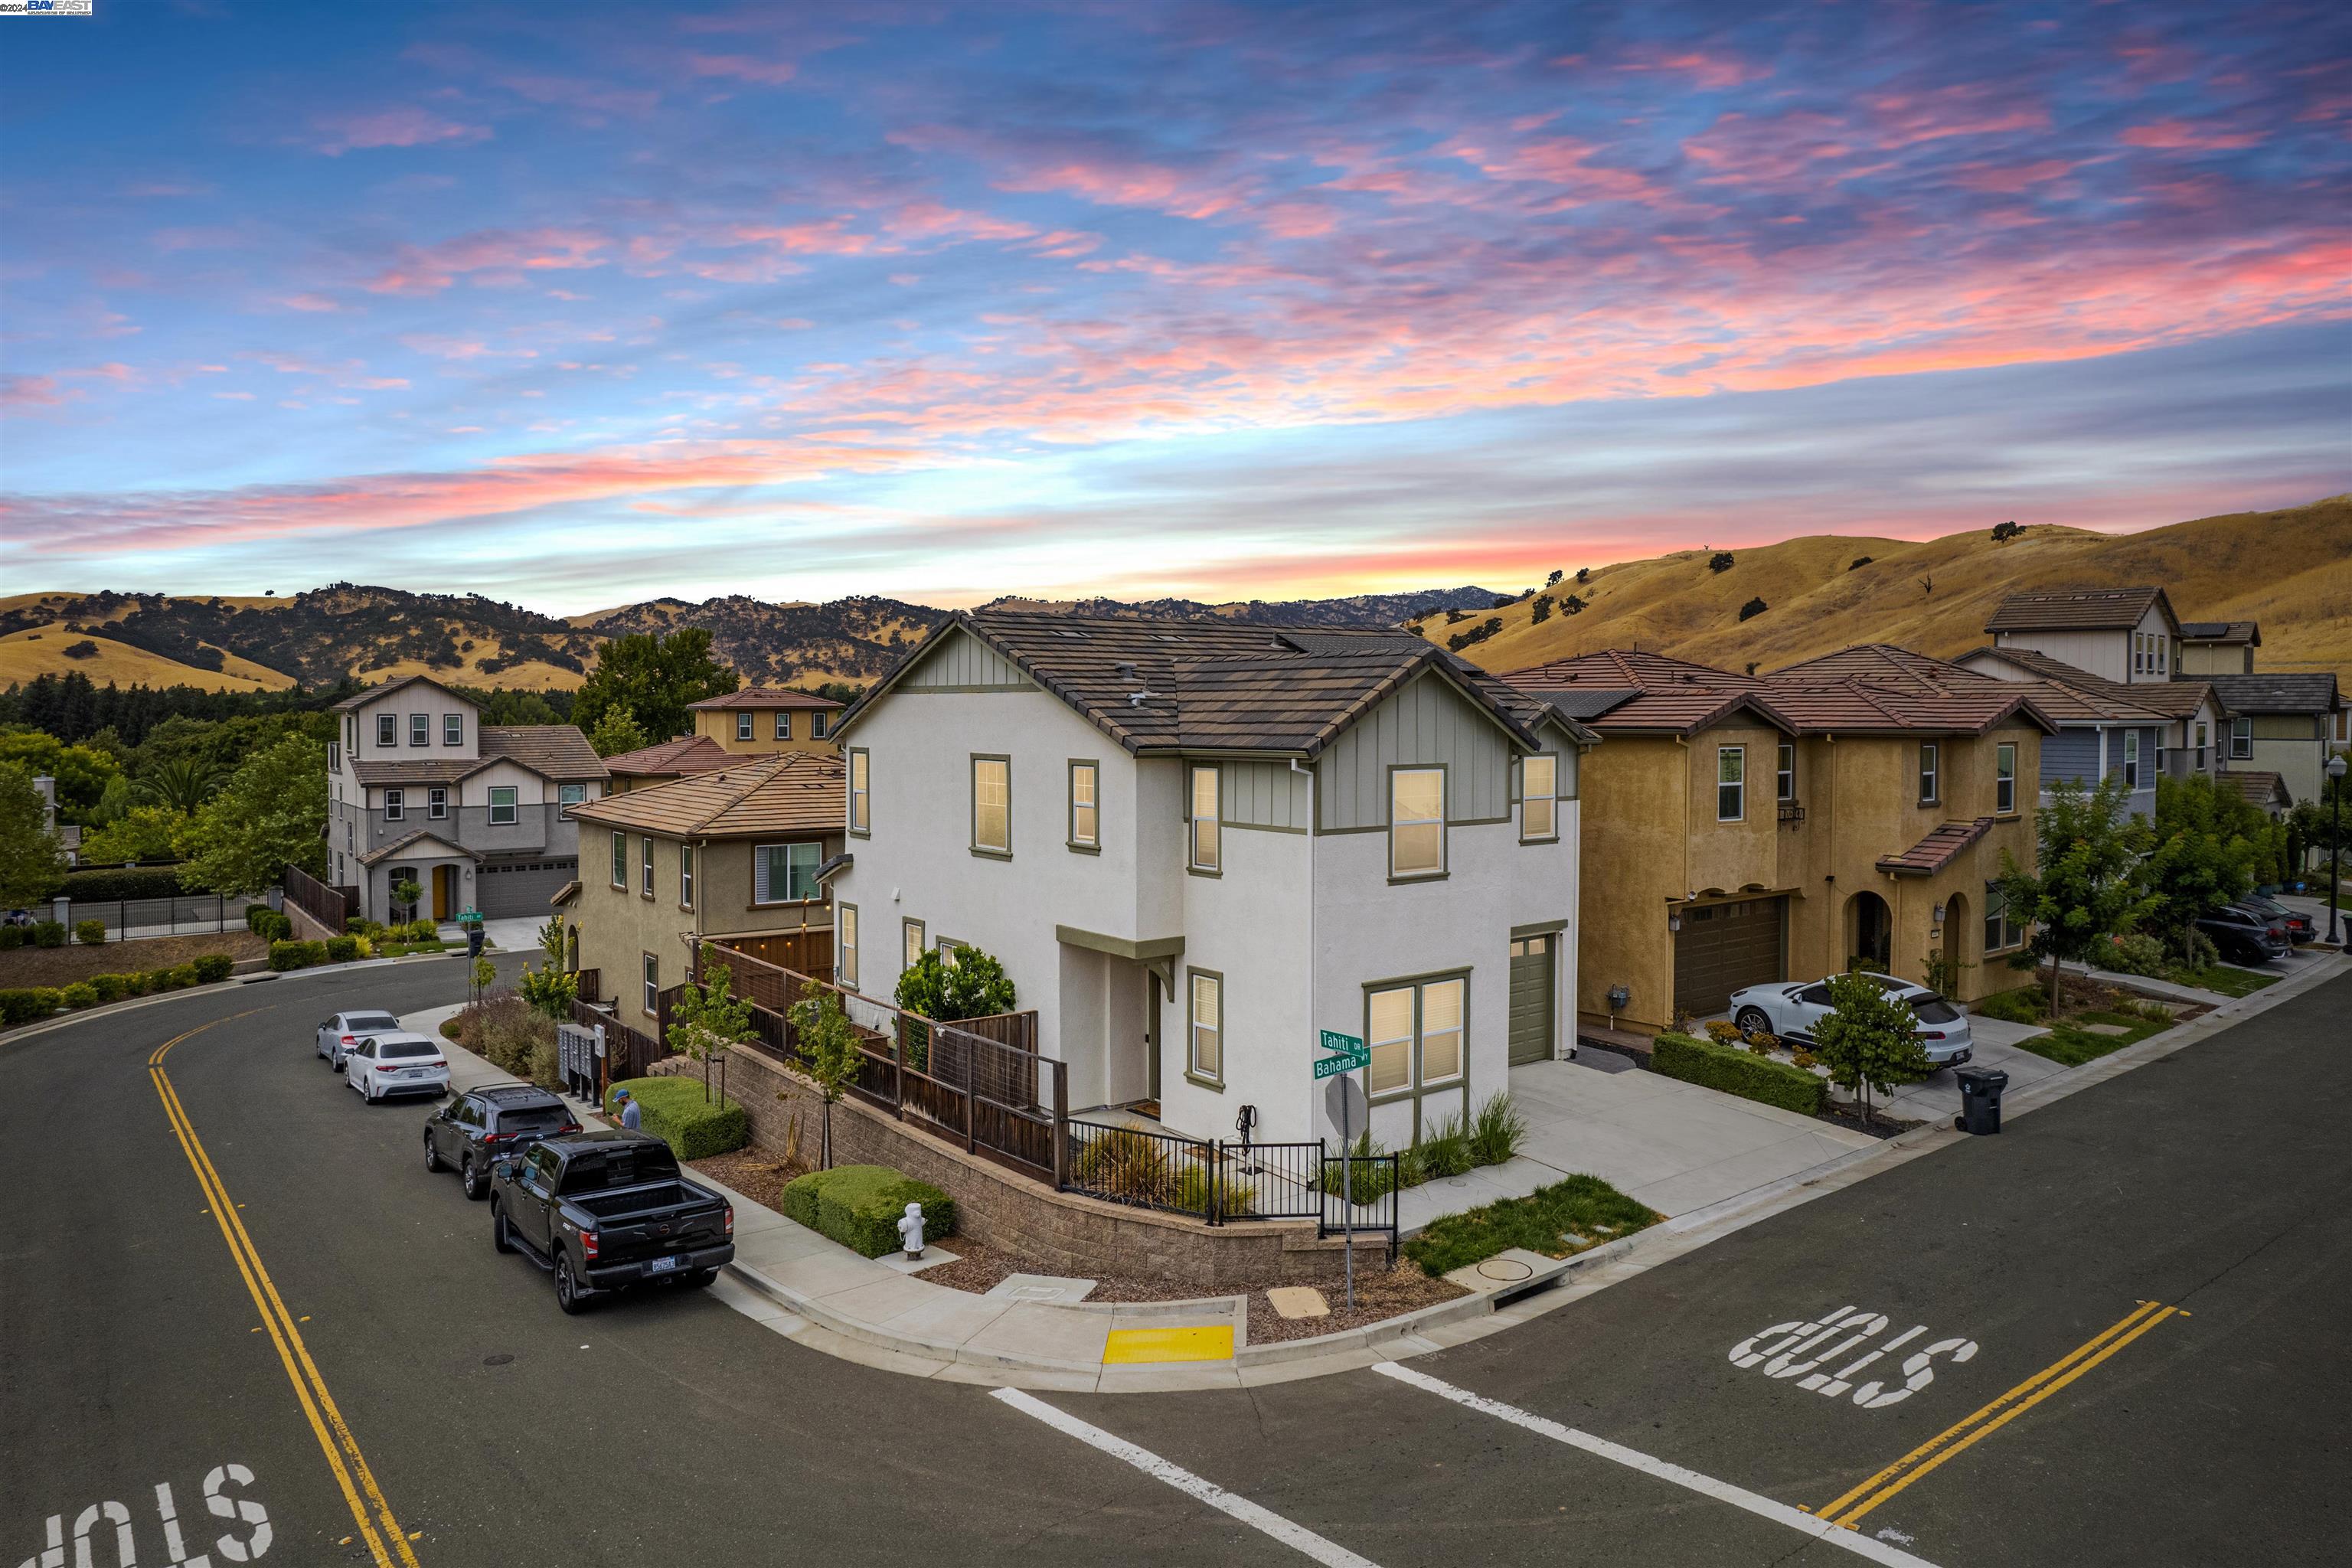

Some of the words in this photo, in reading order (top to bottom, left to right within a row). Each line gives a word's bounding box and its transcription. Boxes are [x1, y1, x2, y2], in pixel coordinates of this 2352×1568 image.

[1322, 1032, 1348, 1050] Tahiti
[1354, 1042, 1361, 1050] DR
[1317, 1057, 1356, 1076] Bahama
[1729, 1305, 1978, 1408] STOP
